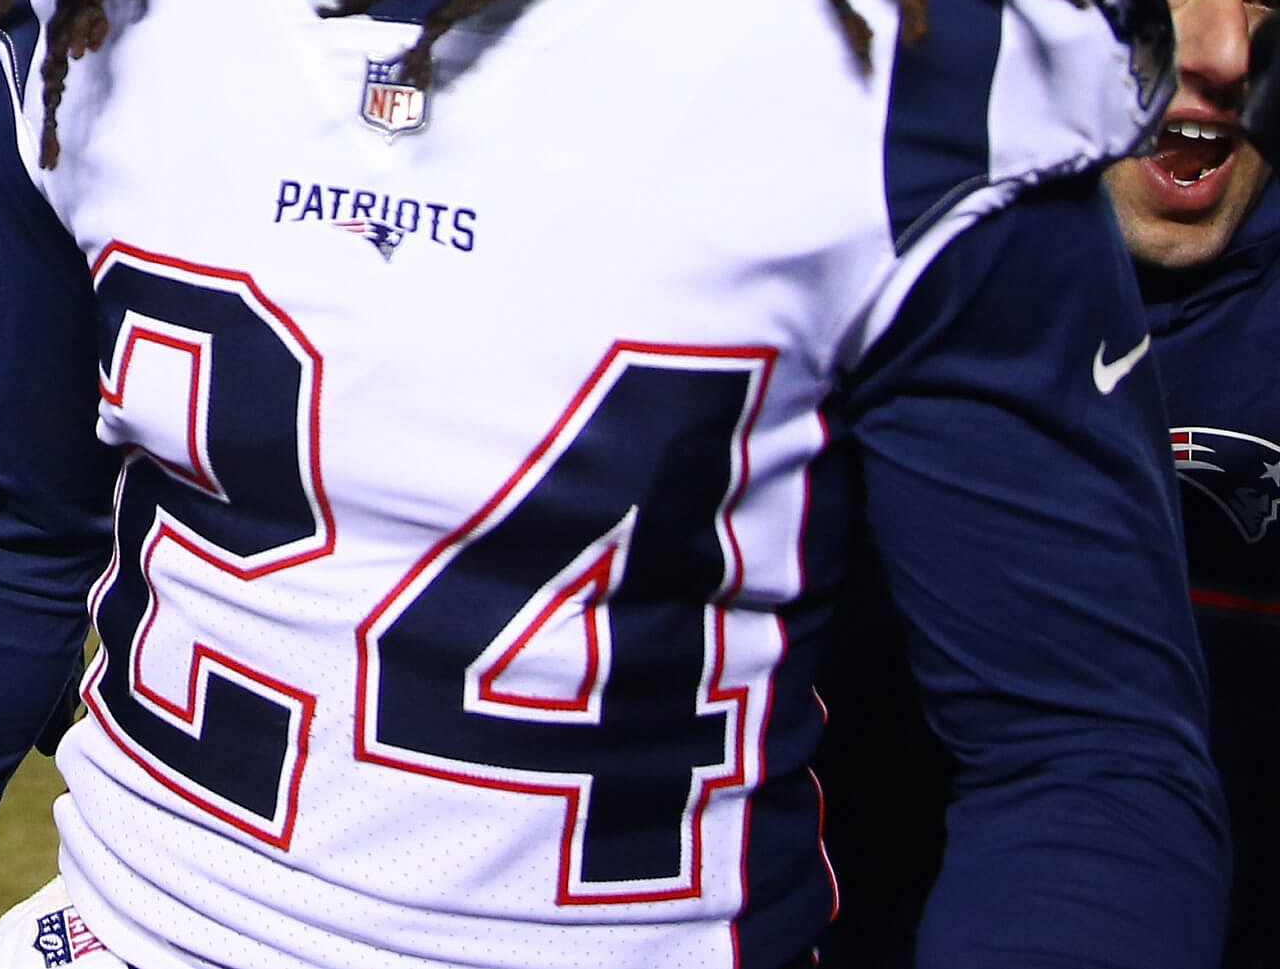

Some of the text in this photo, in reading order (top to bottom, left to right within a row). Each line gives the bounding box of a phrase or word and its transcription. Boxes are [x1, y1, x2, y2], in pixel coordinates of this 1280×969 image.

[369, 88, 419, 124] NFL
[273, 179, 477, 252] PATRIOTS
[81, 239, 778, 907] 24
